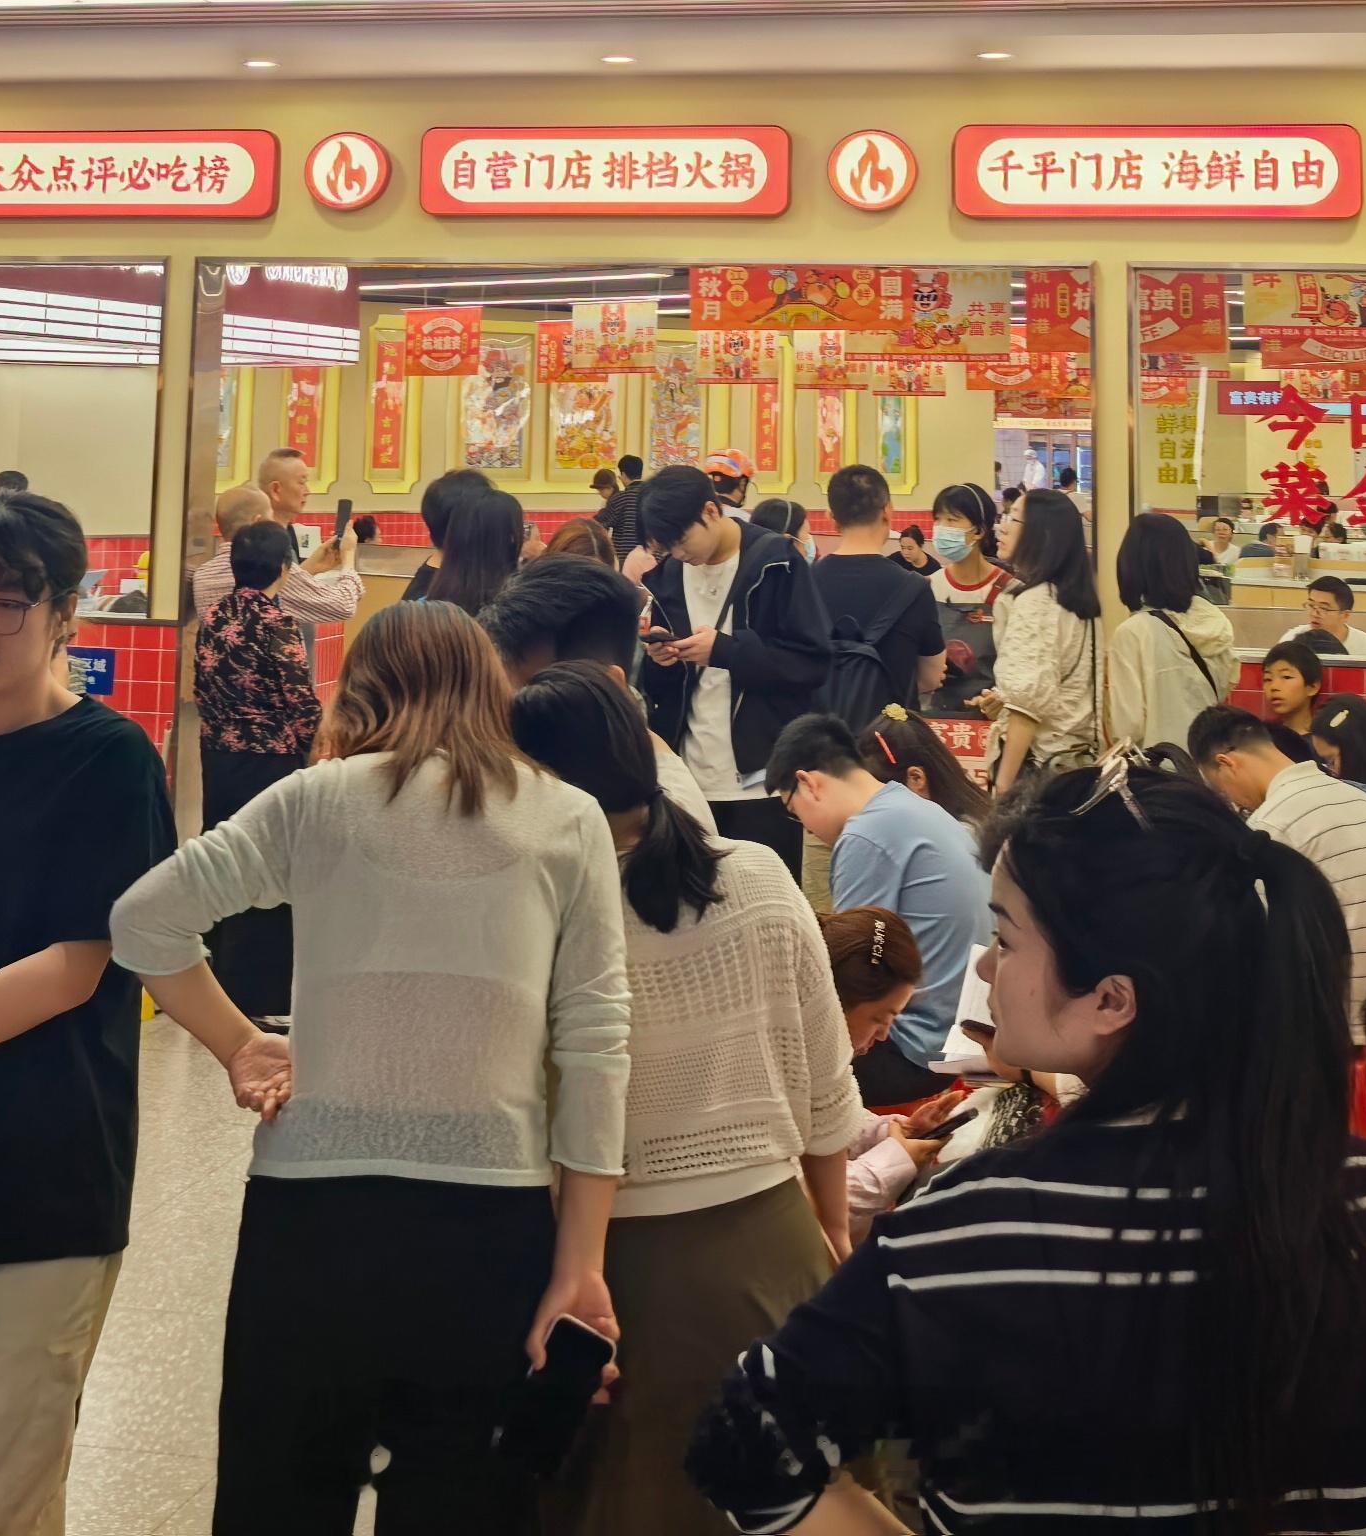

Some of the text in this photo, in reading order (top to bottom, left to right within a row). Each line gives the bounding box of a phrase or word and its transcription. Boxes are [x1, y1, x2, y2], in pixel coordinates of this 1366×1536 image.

[452, 150, 757, 191] 自营门店排档火锅
[986, 149, 1326, 193] 千平门店 海鲜自由
[878, 268, 904, 321] 圆满
[1260, 328, 1282, 336] RICH
[1284, 328, 1300, 336] SEA
[1316, 329, 1336, 337] RICH
